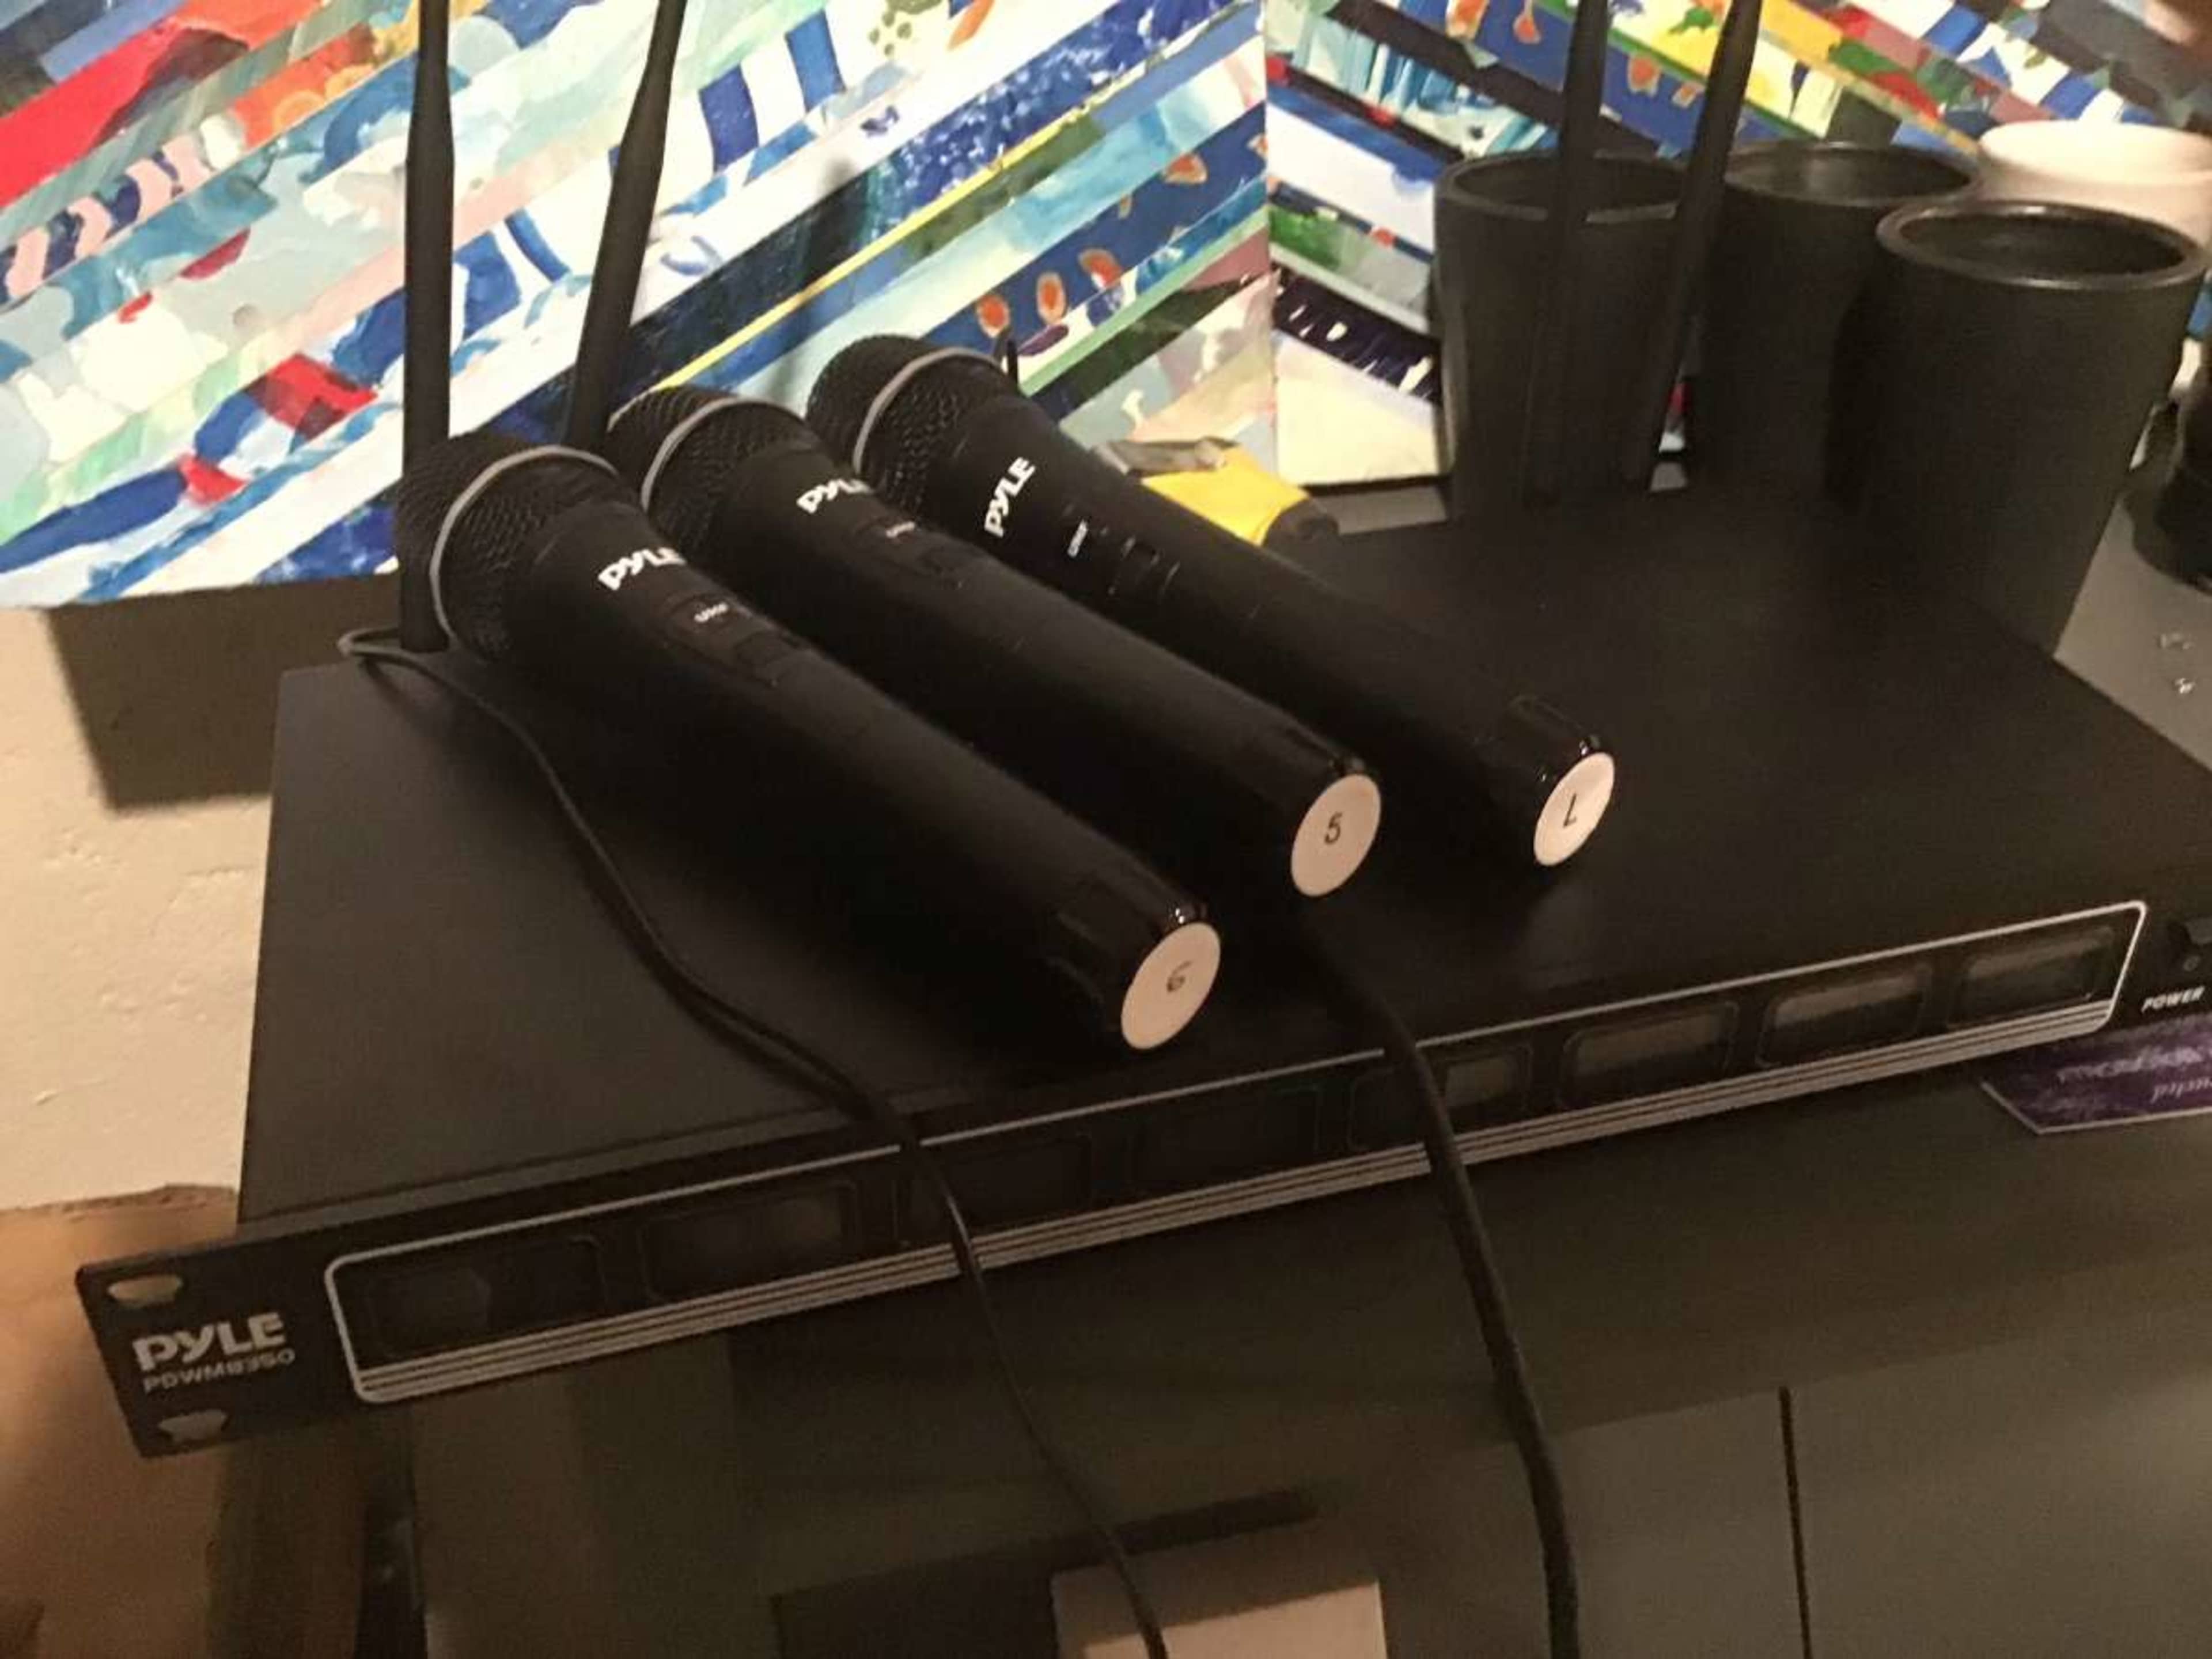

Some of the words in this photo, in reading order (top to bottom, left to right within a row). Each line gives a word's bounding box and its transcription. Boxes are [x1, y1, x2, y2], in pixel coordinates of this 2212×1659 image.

[796, 478, 874, 513] PYLE
[984, 457, 1036, 537] PYLE
[598, 547, 685, 590] PYLE
[1324, 812, 1343, 846] 5
[2141, 986, 2206, 1014] POWER
[132, 1312, 286, 1372] PYLE
